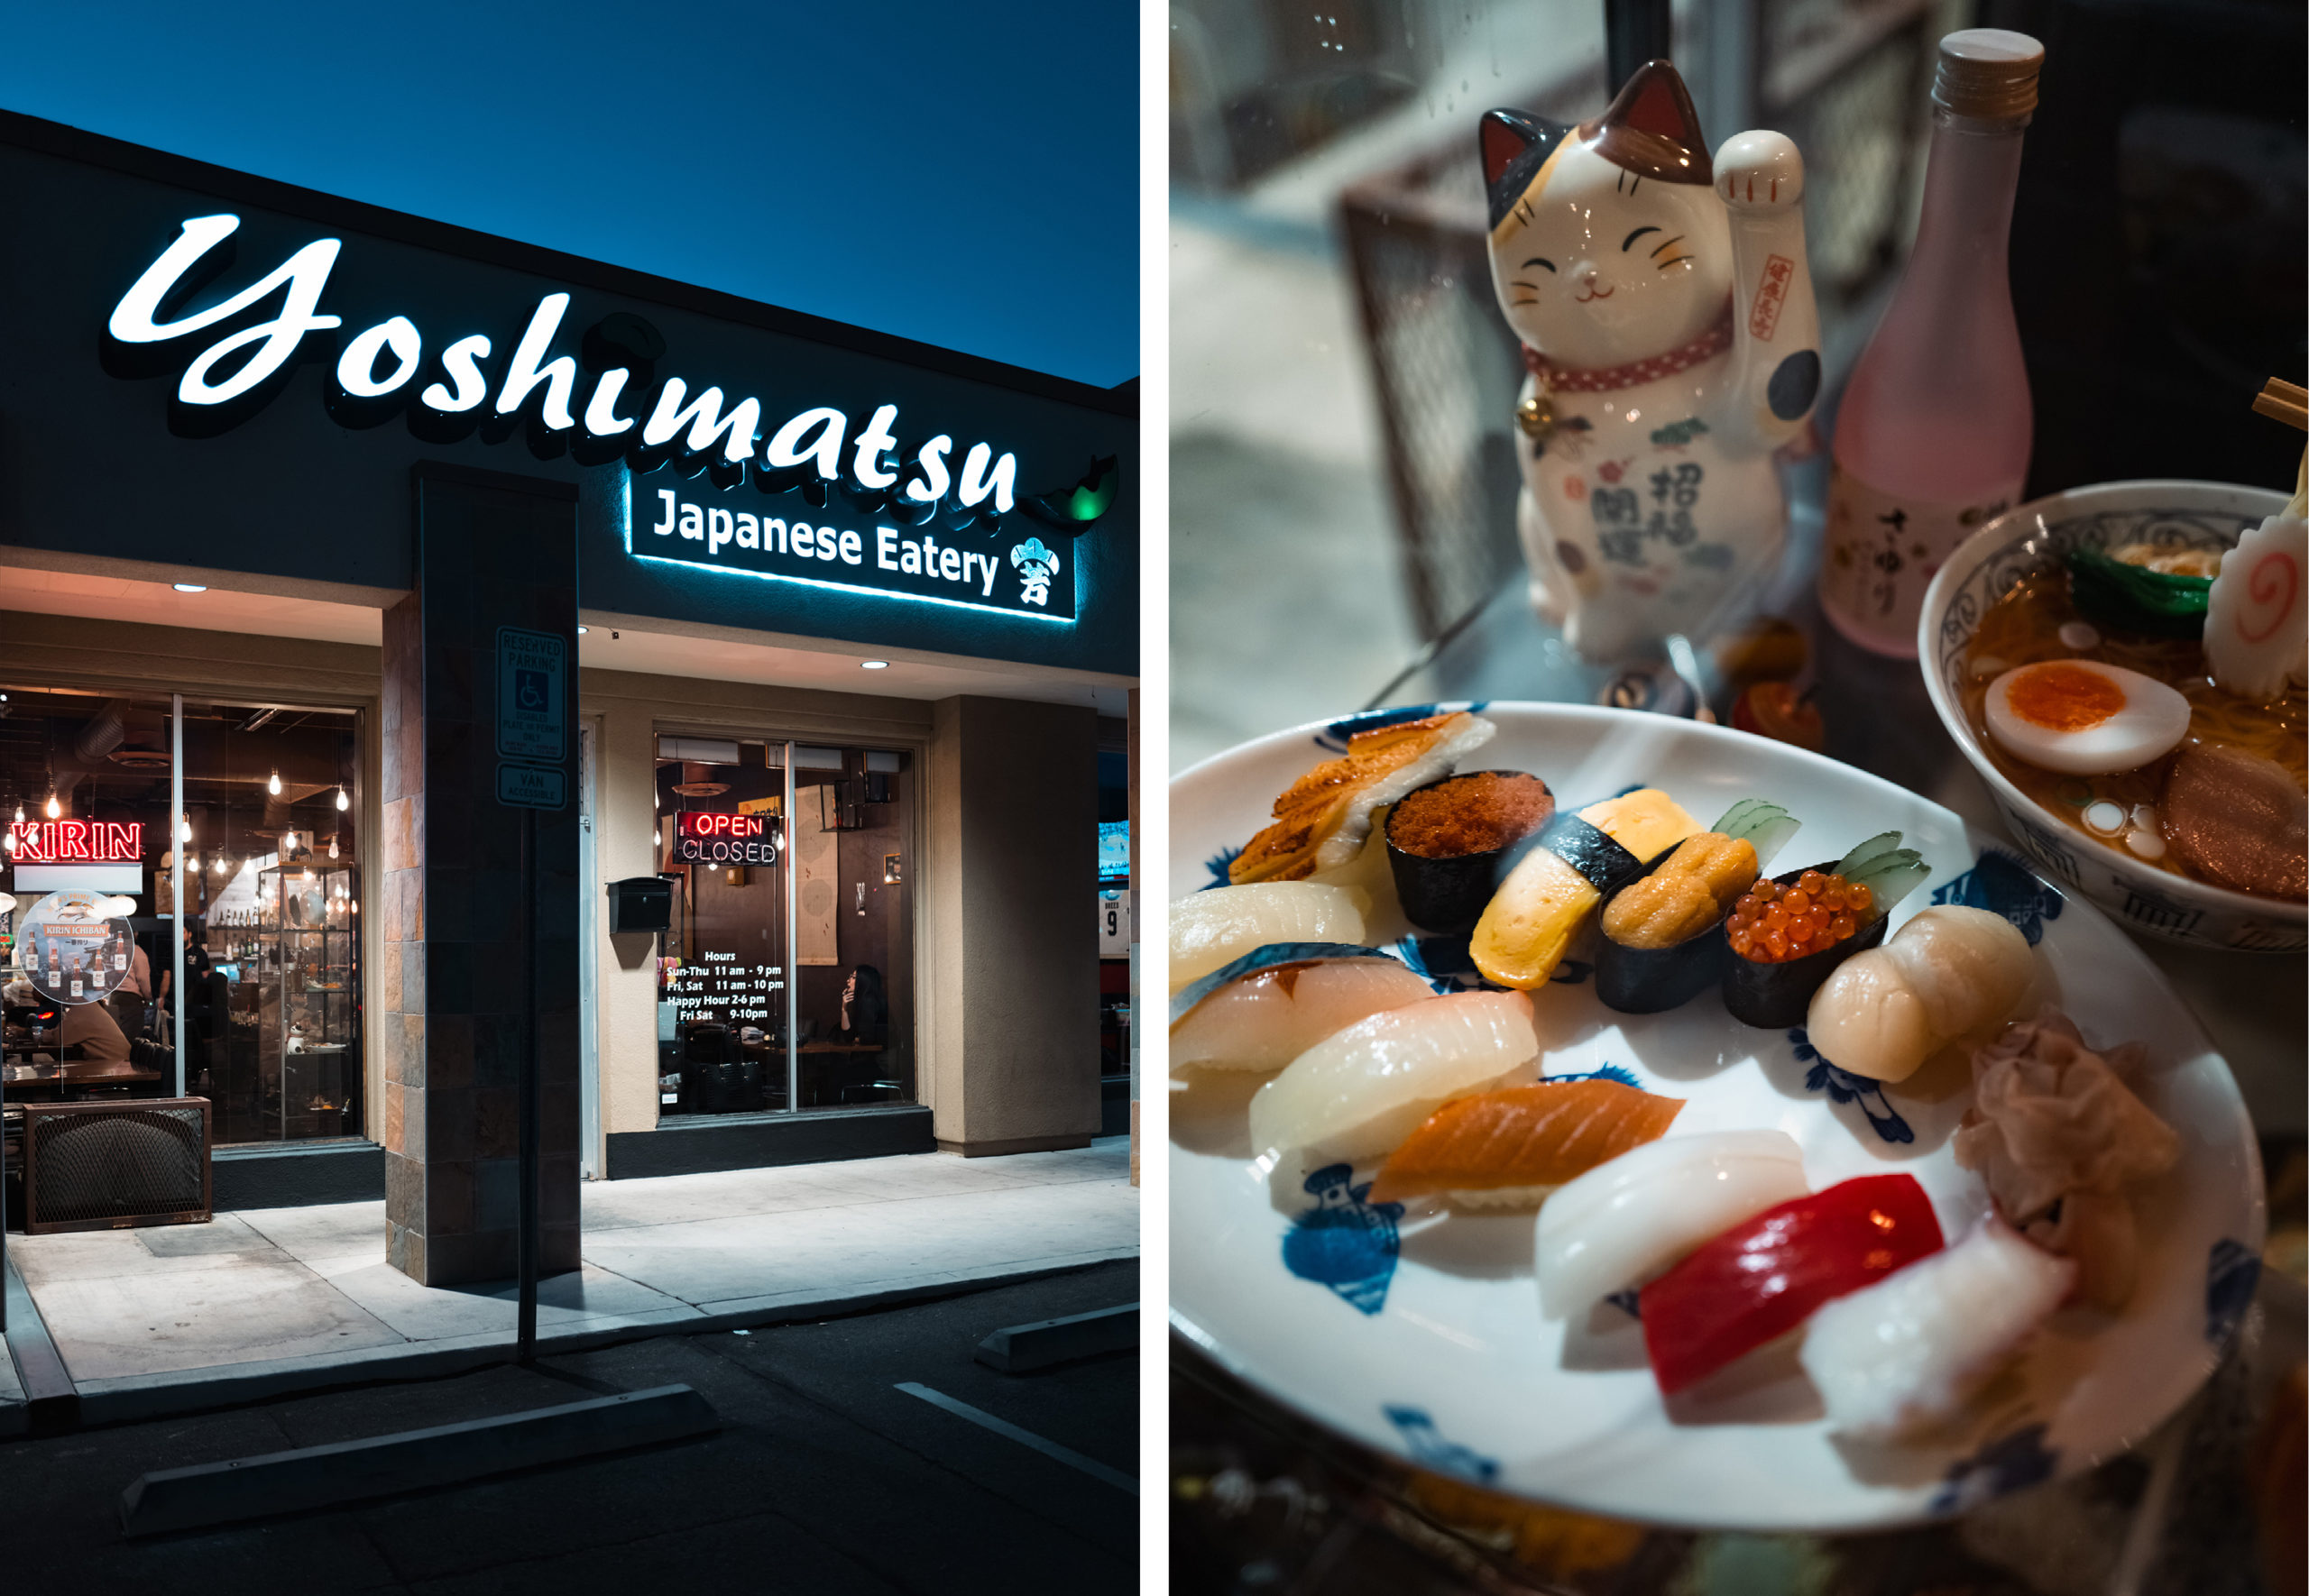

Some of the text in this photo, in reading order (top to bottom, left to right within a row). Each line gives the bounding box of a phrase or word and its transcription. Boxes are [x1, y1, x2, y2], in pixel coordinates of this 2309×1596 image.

[109, 214, 1017, 513] Yoshimatsu
[654, 490, 999, 596] Japanese Eatery
[504, 634, 561, 656] RESERVED
[509, 652, 557, 673] PARKING
[520, 772, 544, 787] VAN
[696, 815, 762, 837] OPEN
[11, 821, 141, 860] KIRIN
[683, 839, 776, 863] CLOSED
[46, 926, 106, 935] KIRIN ICHIBAN
[1107, 910, 1118, 937] 9
[704, 951, 736, 961] Hours
[667, 966, 710, 977] Sun-Thu
[714, 966, 726, 976] 11
[729, 967, 745, 976] am
[757, 965, 764, 975] 9
[765, 966, 782, 977] pm
[667, 981, 685, 992] Fri,
[686, 981, 704, 991] Sat
[716, 980, 727, 990] 11
[730, 981, 746, 990] am
[754, 979, 766, 990] 10
[768, 980, 784, 992] pm
[667, 995, 766, 1008] Happy Hour 2-6 pm
[680, 1009, 768, 1021] Fri Sat 9-10pm
